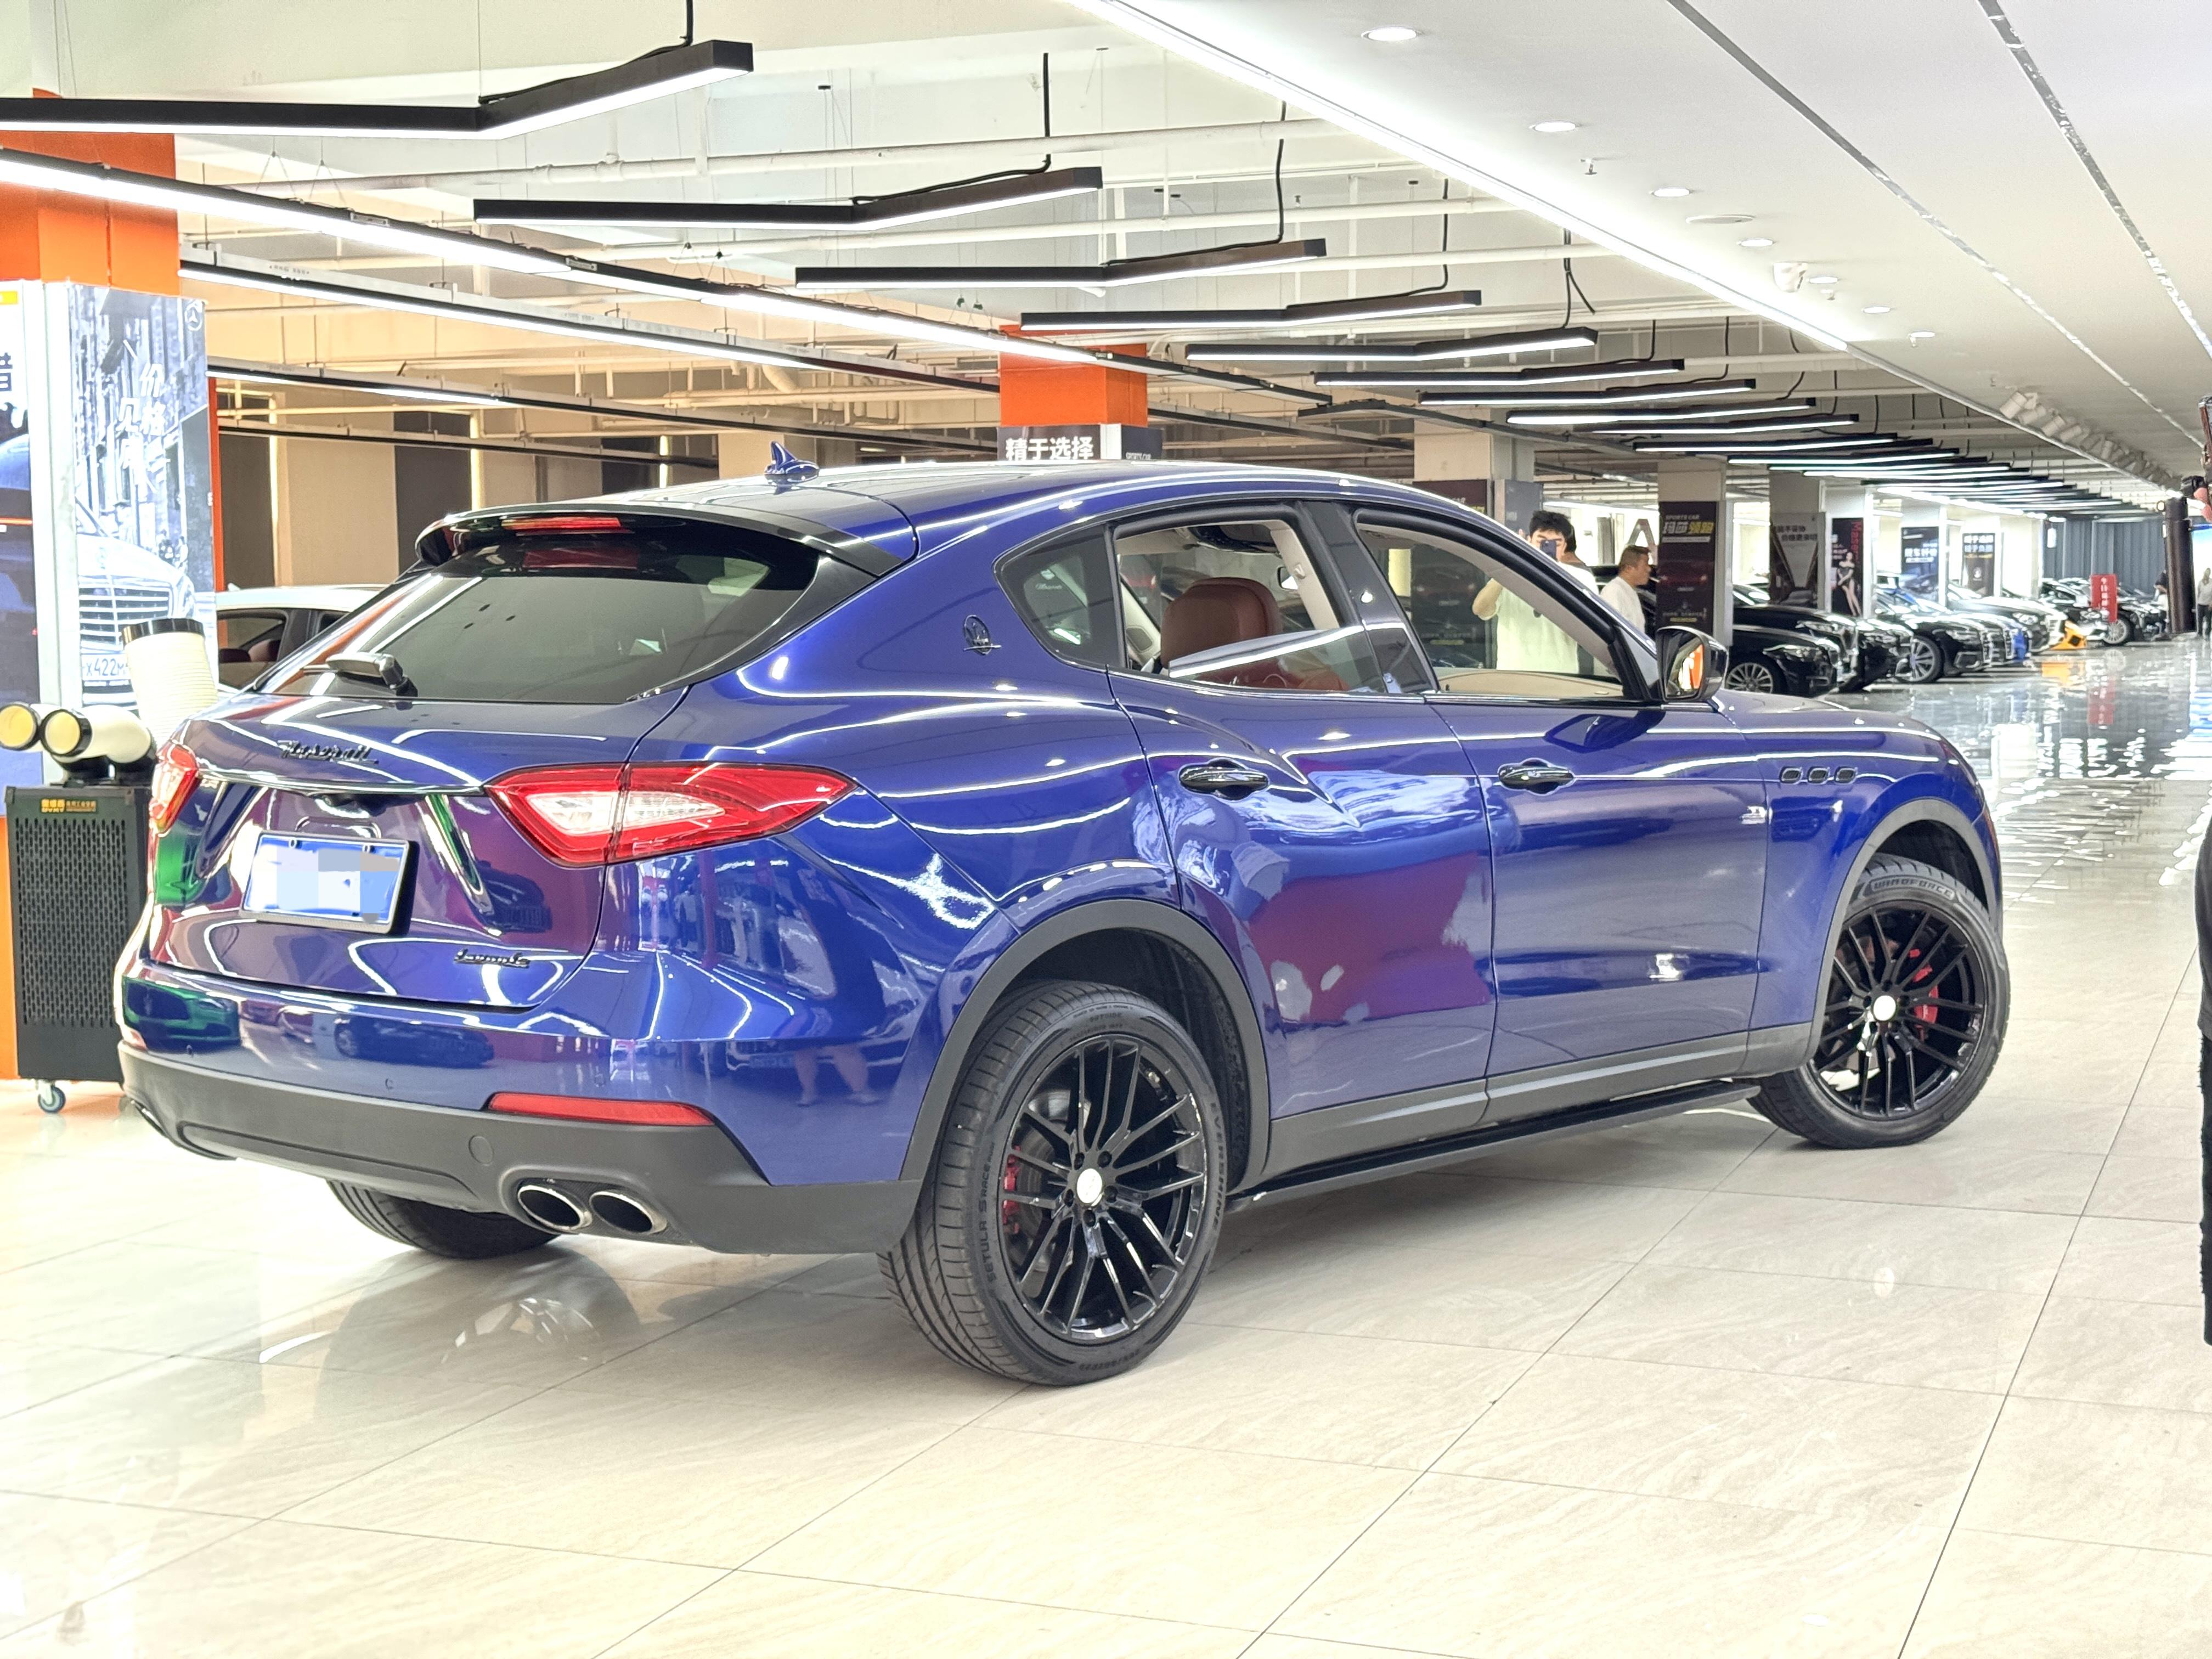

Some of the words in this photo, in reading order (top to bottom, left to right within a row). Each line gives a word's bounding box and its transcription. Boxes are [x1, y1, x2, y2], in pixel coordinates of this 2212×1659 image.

[1005, 436, 1094, 460] 精于选择
[1874, 878, 1954, 900] WINDFORCE
[979, 1220, 997, 1283] SETULA
